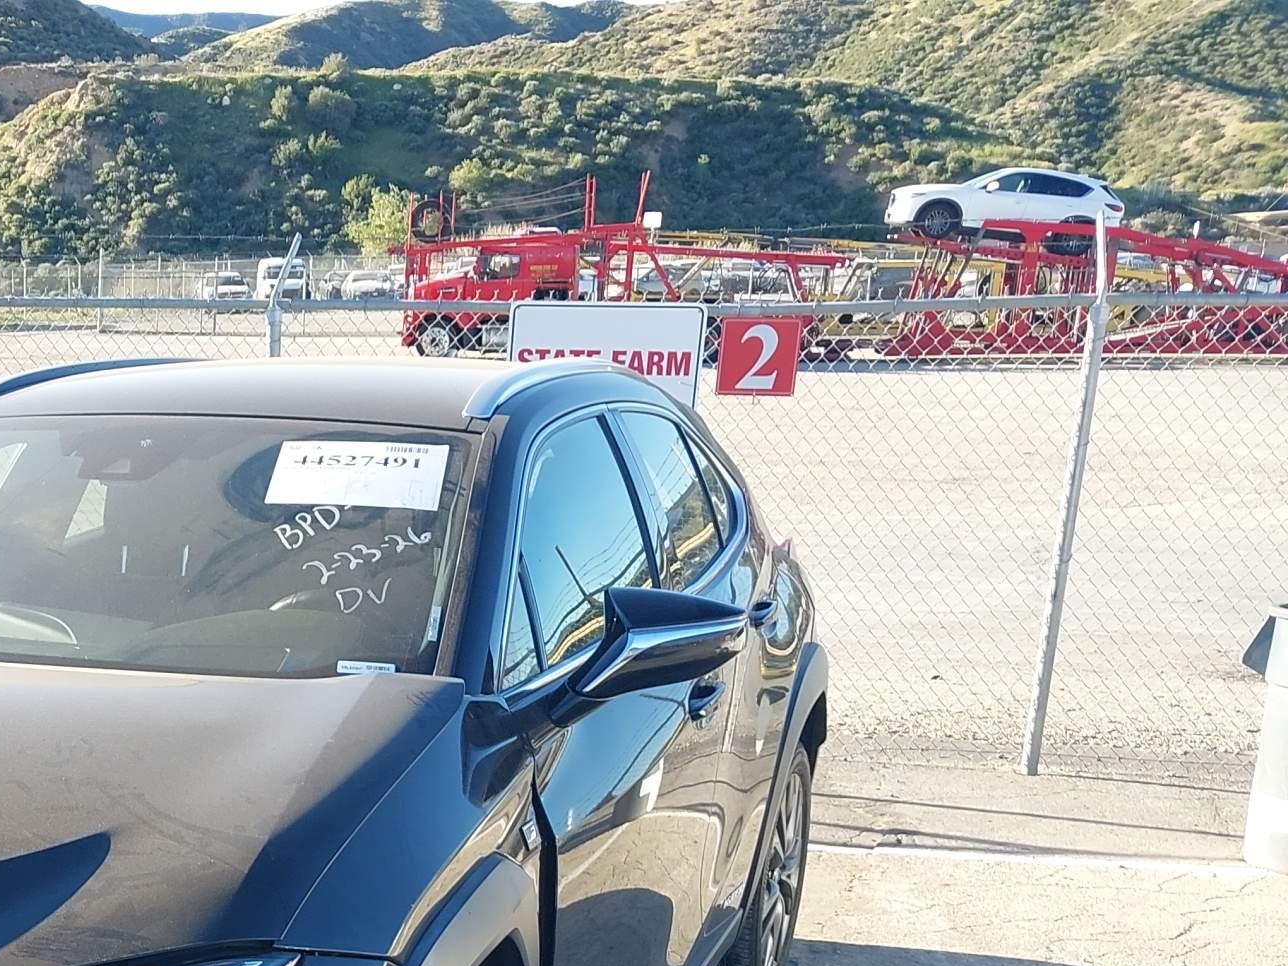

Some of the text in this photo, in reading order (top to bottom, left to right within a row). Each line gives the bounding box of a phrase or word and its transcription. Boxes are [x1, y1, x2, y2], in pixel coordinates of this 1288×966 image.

[612, 350, 692, 377] FARM
[734, 323, 779, 390] 2
[293, 454, 422, 470] 44527491
